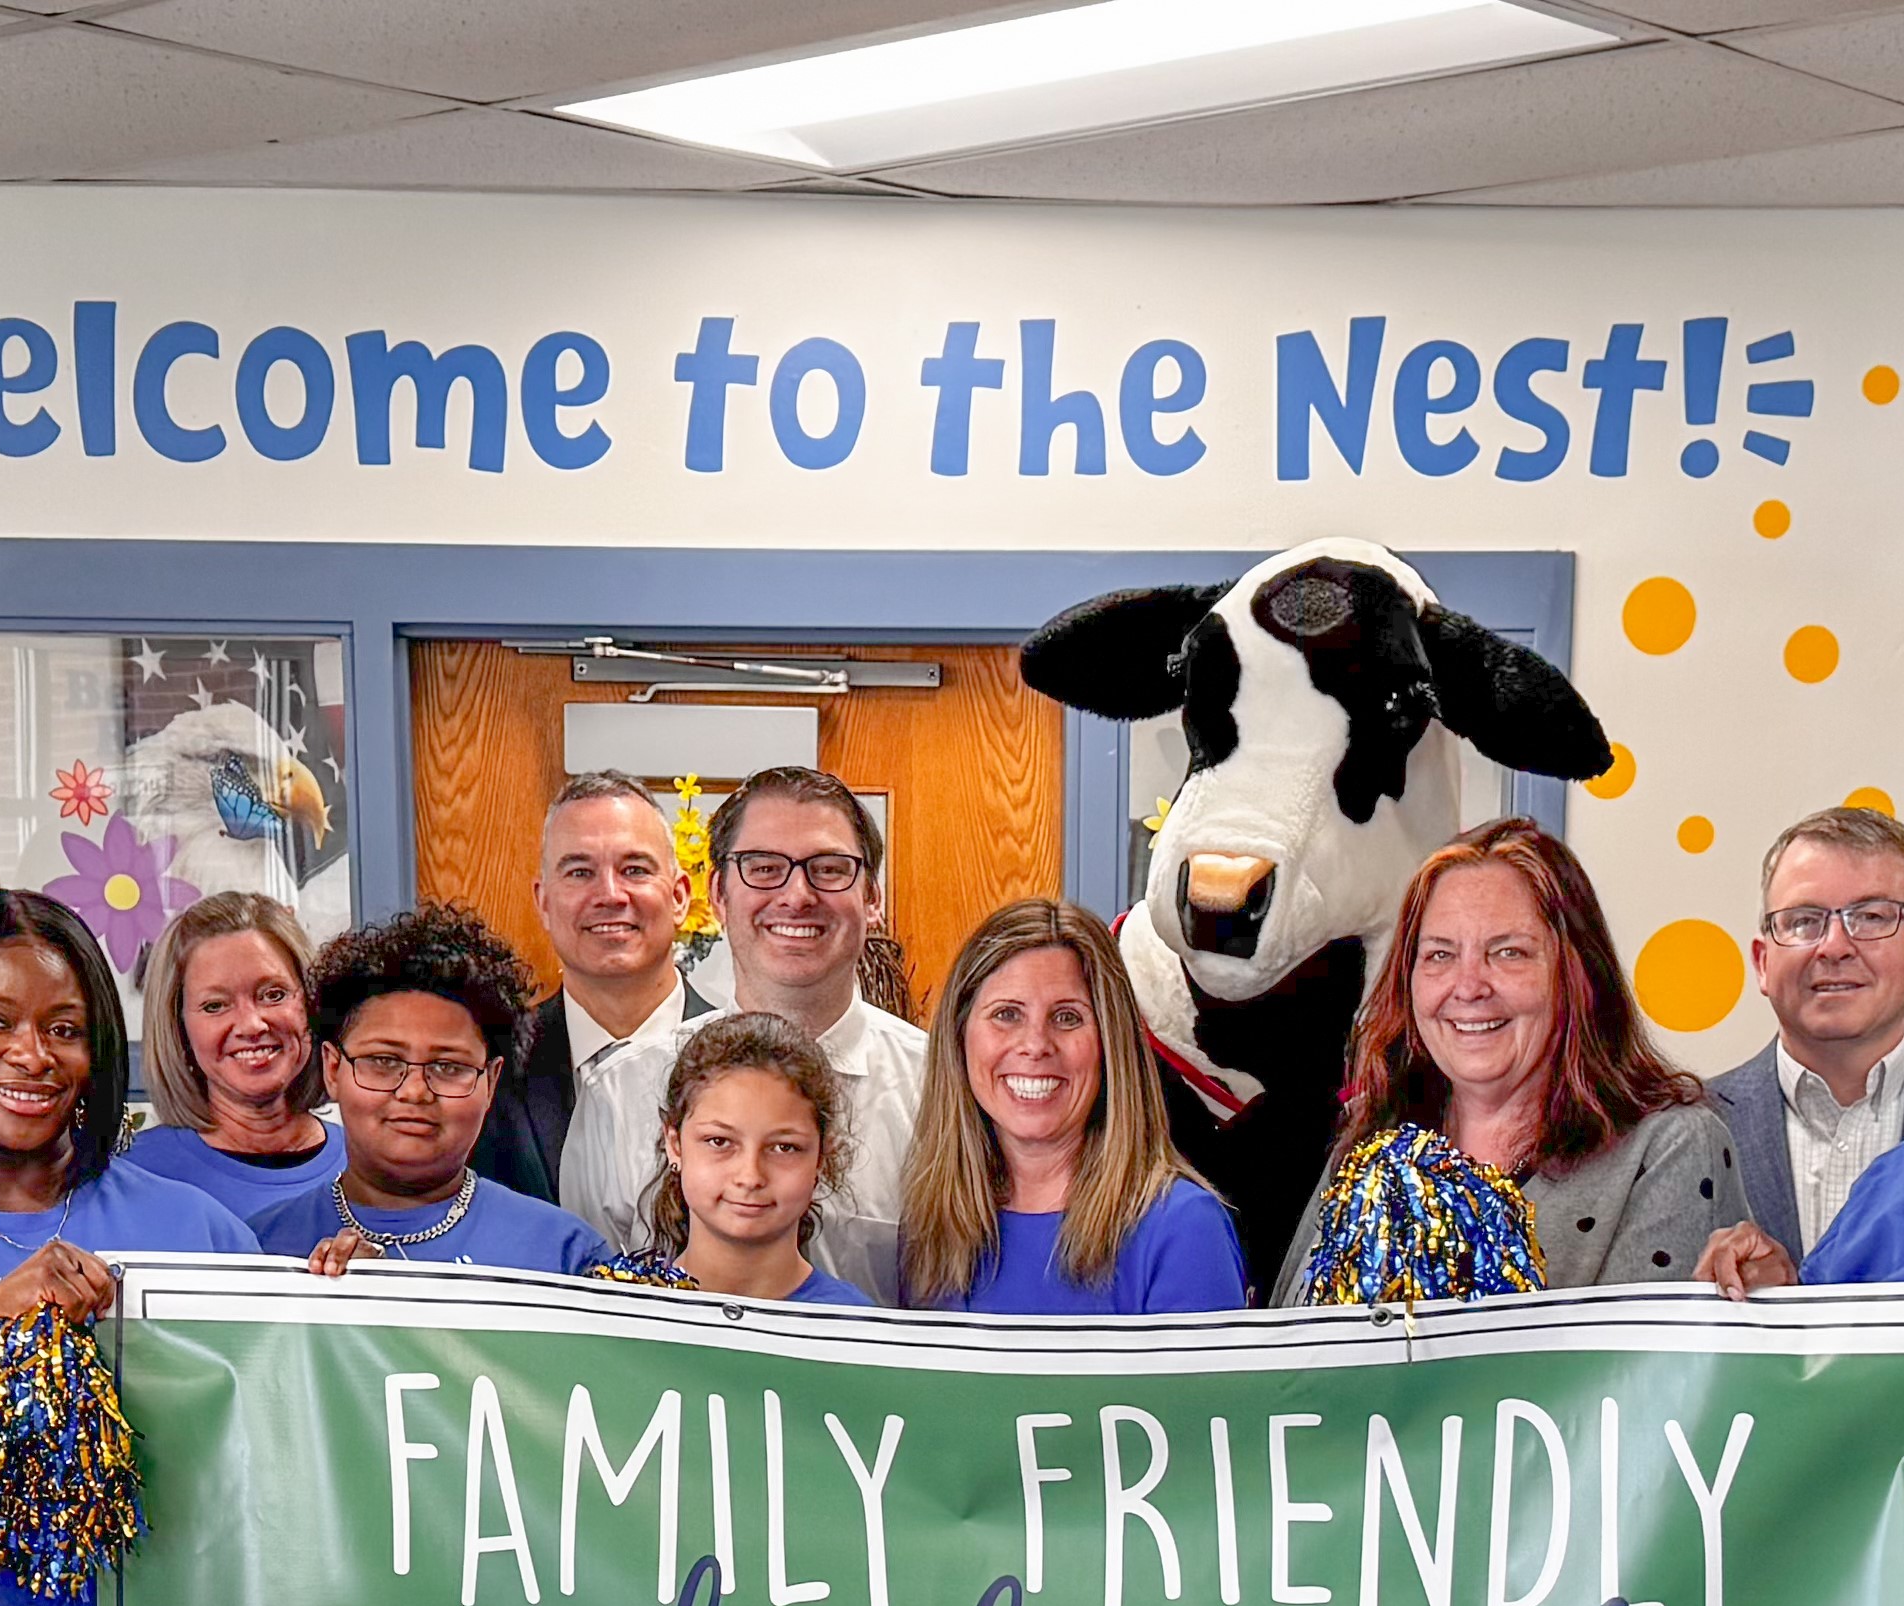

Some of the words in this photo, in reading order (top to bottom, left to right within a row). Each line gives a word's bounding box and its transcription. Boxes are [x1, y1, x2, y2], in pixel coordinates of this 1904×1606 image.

[674, 315, 866, 473] to
[920, 317, 1207, 478] the
[1275, 315, 1729, 482] Nest!
